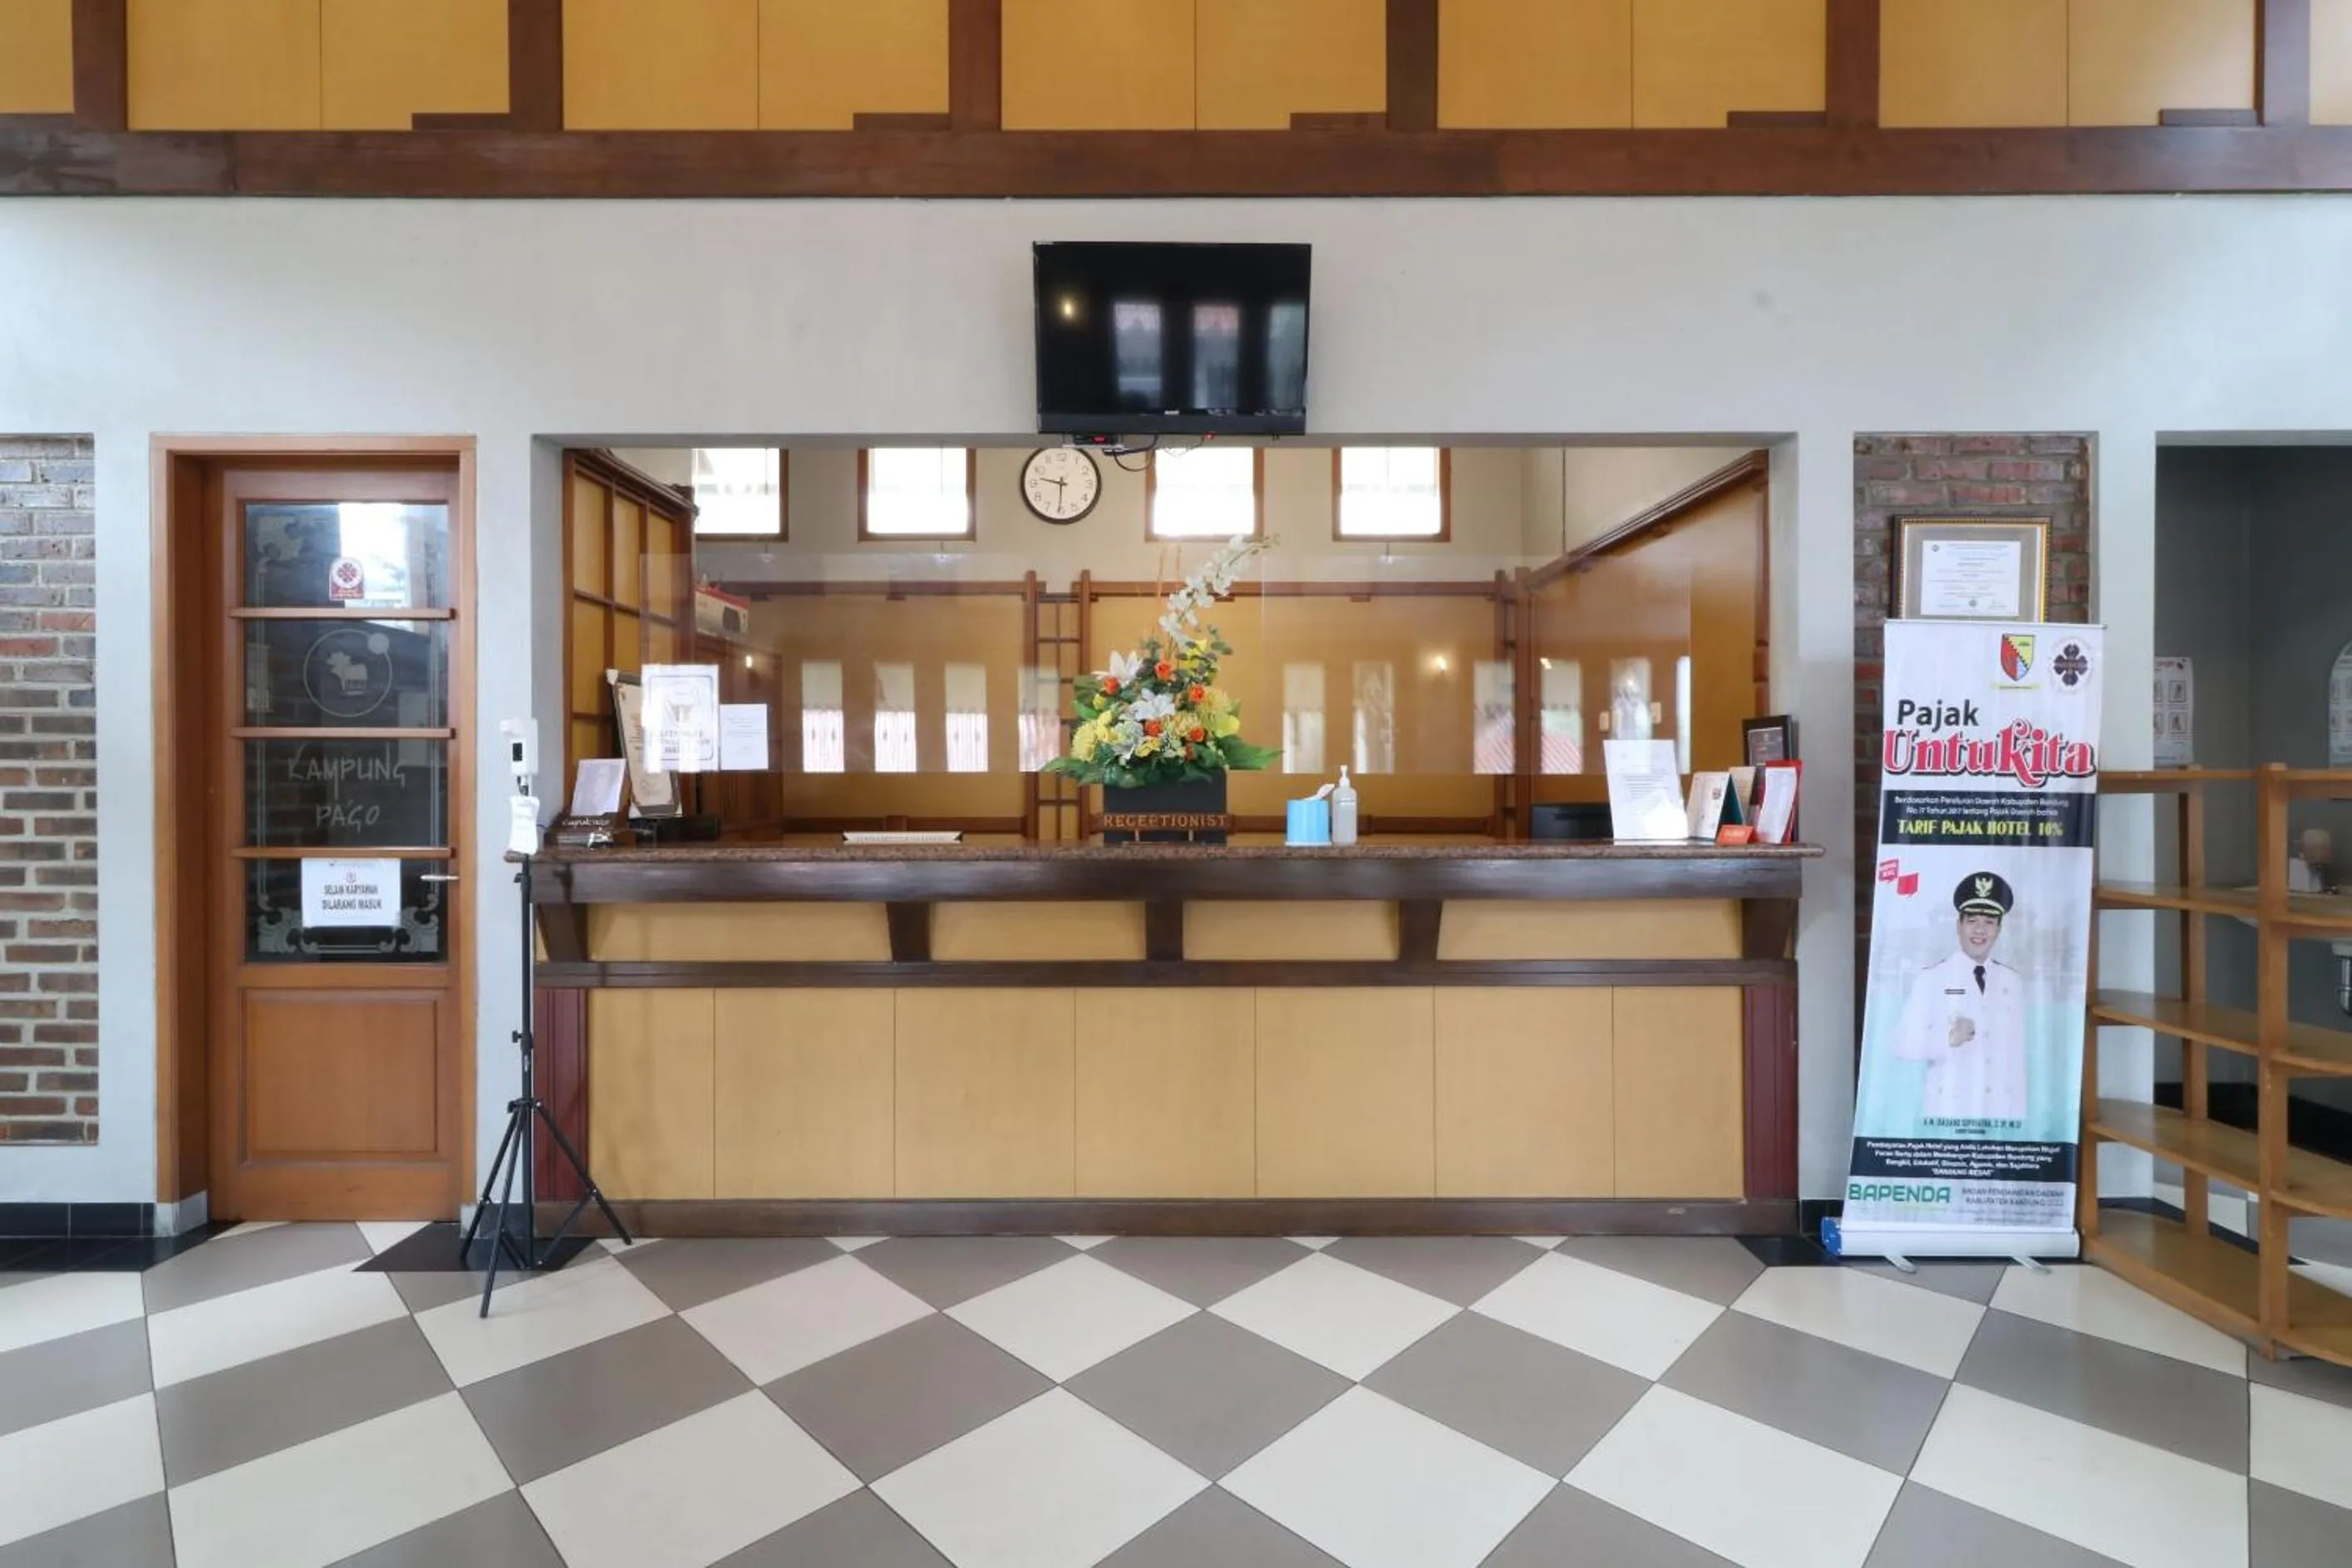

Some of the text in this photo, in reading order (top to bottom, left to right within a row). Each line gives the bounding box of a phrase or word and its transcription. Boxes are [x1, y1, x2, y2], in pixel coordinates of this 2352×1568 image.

[1055, 453, 1067, 462] 12
[1897, 699, 1979, 733] Pajak
[288, 741, 408, 800] KAMPUNG
[1104, 813, 1228, 828] RECEPTIONIST
[1897, 818, 2064, 836] TARIF PAJAK HOTEL 10%
[322, 899, 382, 911] DILARANG MASUK
[1848, 1183, 1951, 1203] BAPENDA
